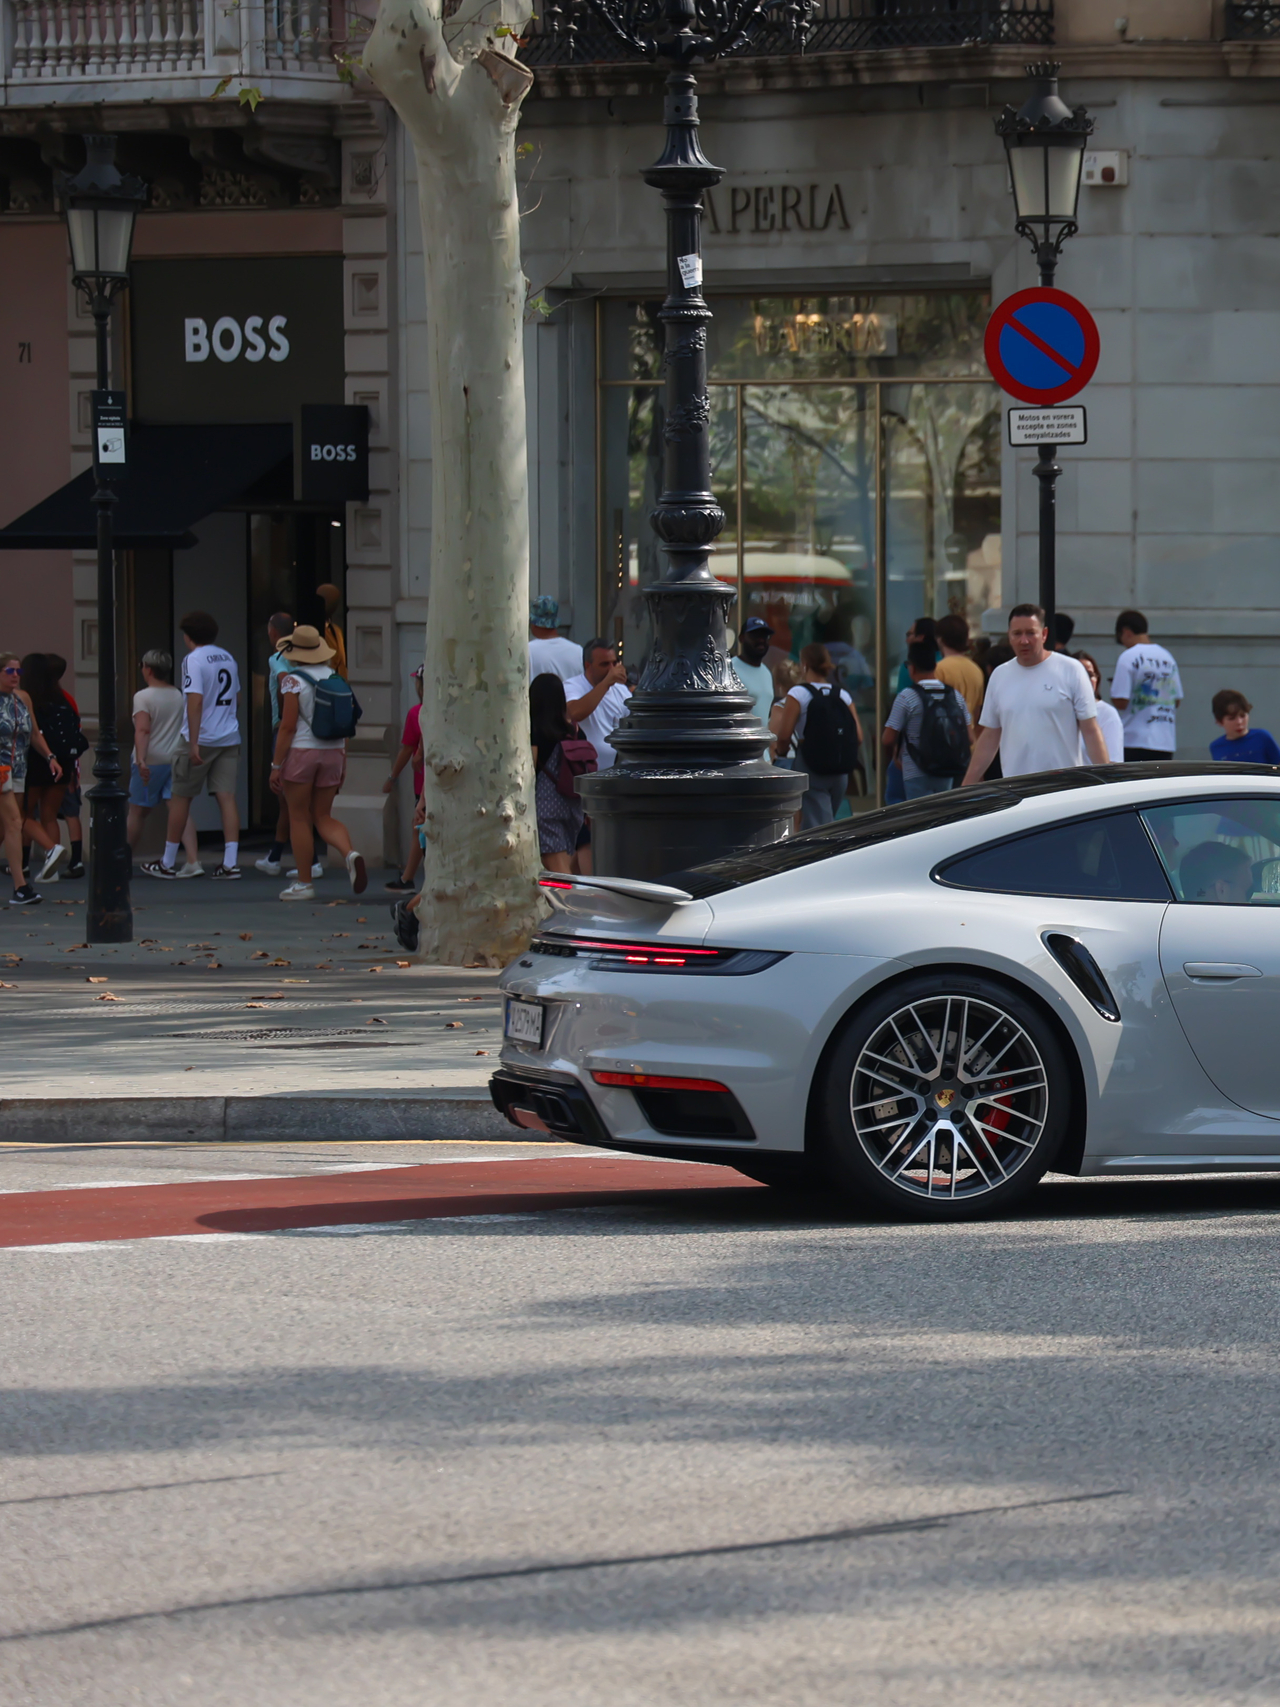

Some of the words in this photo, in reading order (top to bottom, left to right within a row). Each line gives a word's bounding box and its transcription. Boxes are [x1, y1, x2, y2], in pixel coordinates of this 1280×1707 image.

[700, 187, 722, 234] A
[726, 183, 851, 234] PERLA
[18, 341, 31, 363] 71
[185, 315, 290, 363] BOSS
[1017, 423, 1044, 431] excepte
[311, 444, 357, 461] BOSS
[215, 668, 233, 707] 2
